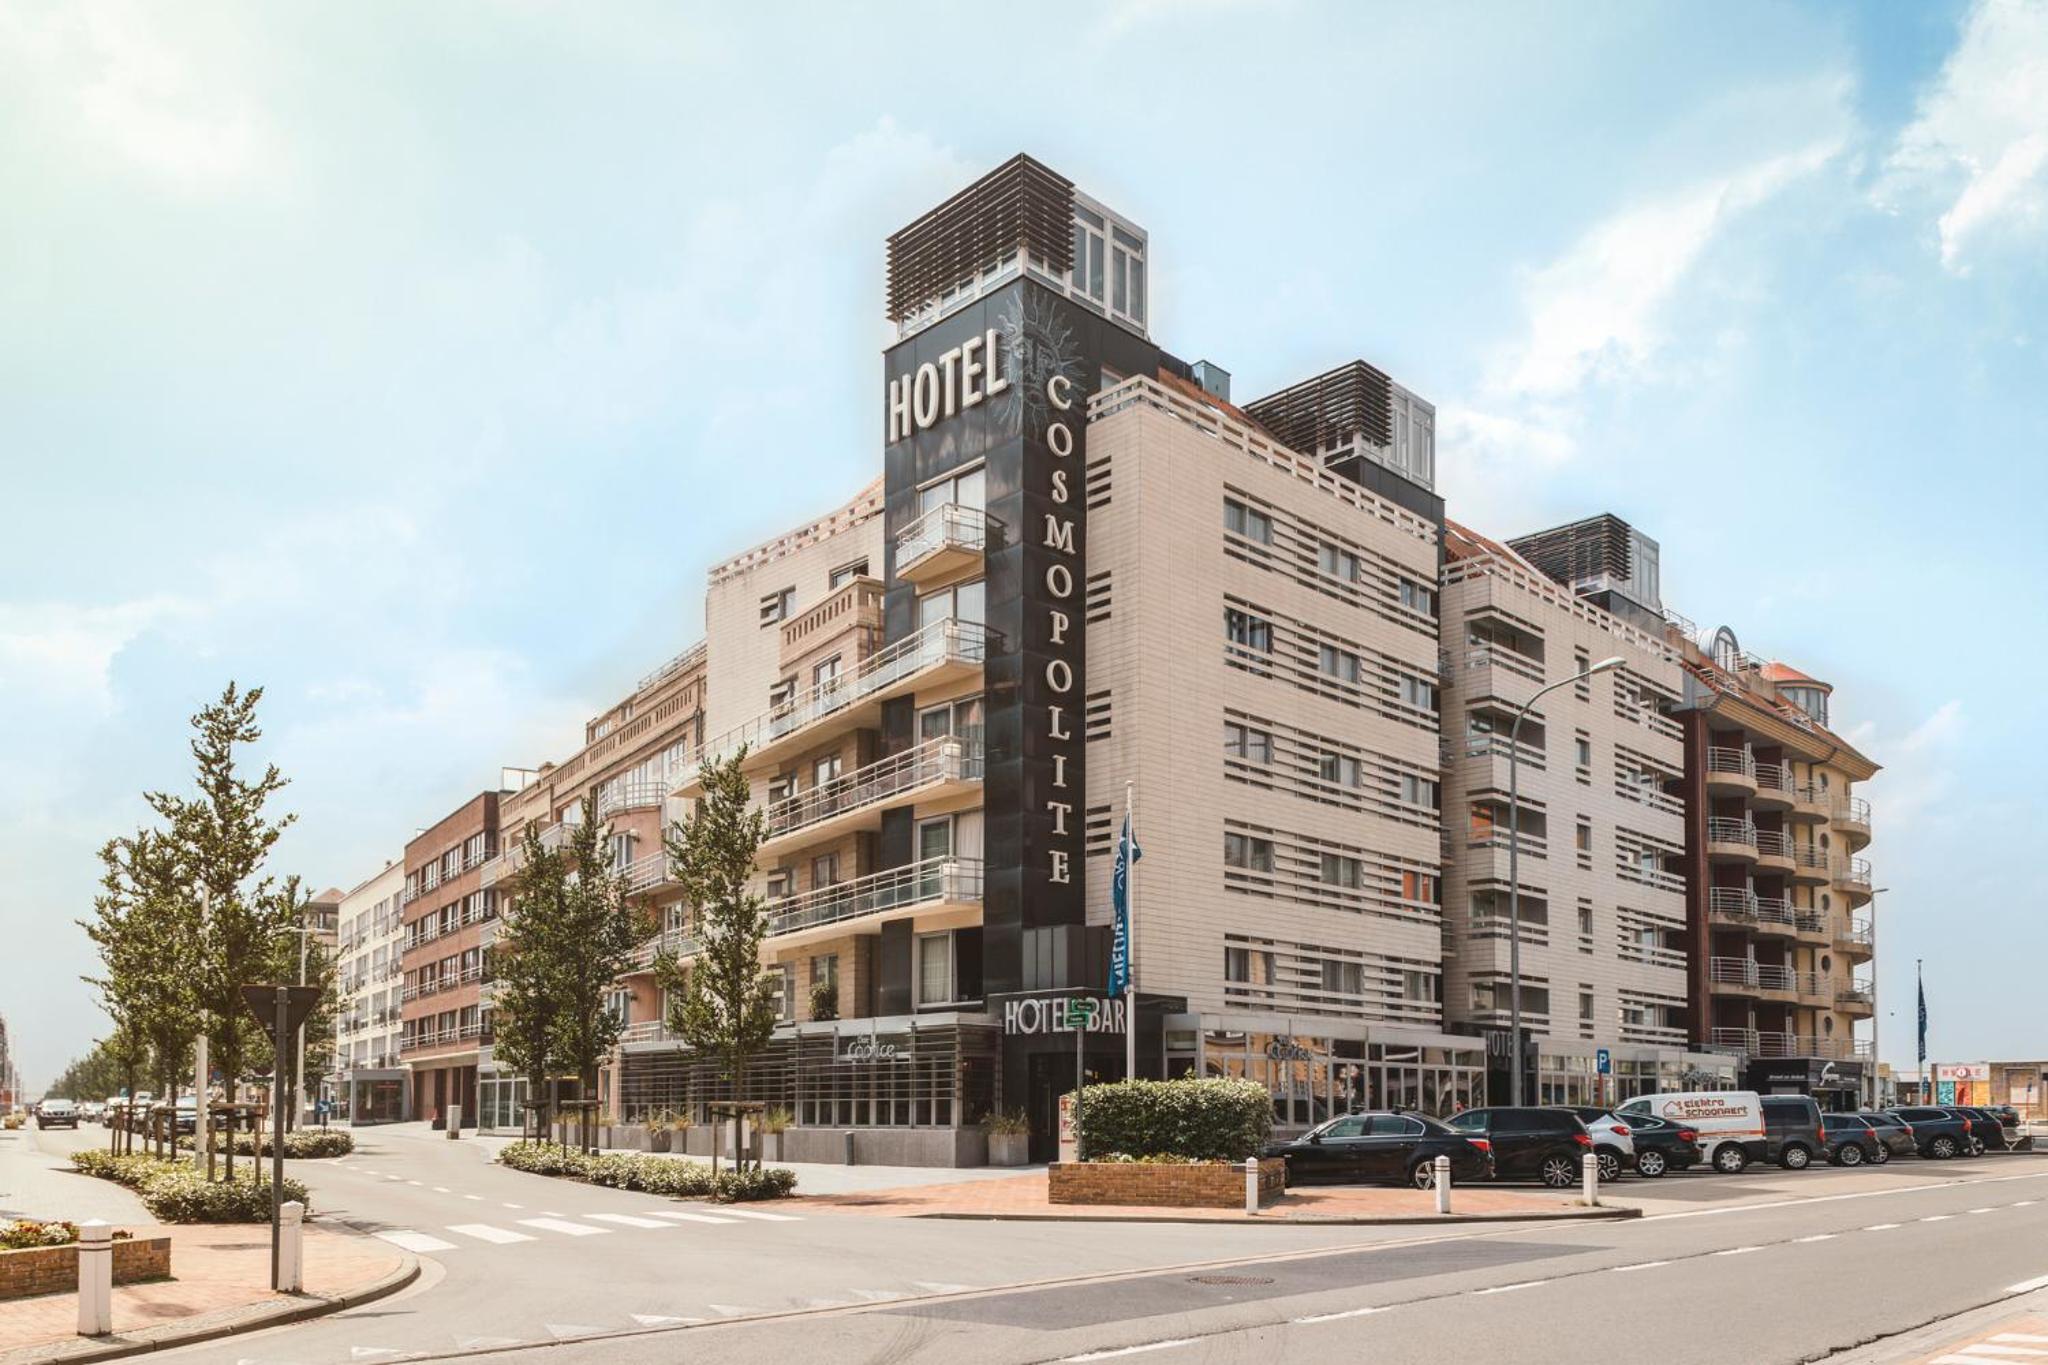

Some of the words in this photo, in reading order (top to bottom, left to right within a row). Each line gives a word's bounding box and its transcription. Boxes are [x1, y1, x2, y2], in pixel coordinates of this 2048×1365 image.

[890, 328, 1007, 442] HOTEL
[1043, 376, 1076, 884] COSMOPOLITE
[1005, 998, 1074, 1035] HOTEL
[1086, 997, 1125, 1034] BAR
[1599, 1053, 1607, 1070] P
